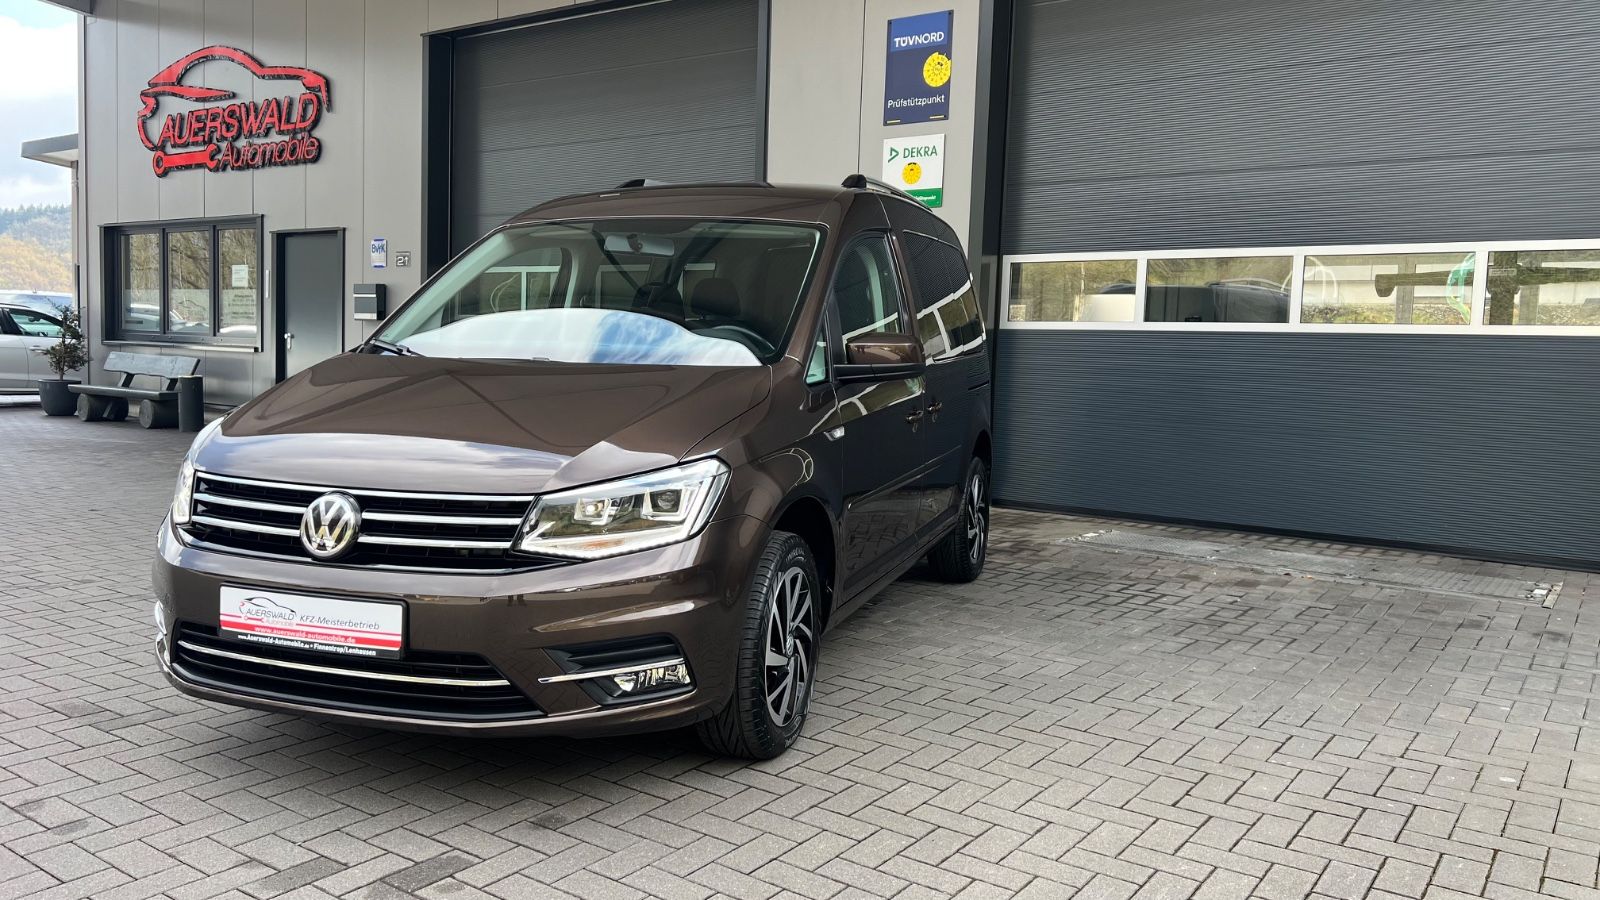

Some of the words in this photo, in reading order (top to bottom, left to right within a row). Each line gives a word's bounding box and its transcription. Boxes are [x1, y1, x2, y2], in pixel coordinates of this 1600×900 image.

[887, 94, 945, 109] Prüfstützpunkt
[156, 91, 320, 148] AUERSWALD
[218, 132, 320, 170] Automobile
[902, 145, 938, 159] DEKRA
[246, 607, 295, 621] AUERSWALD
[299, 614, 380, 630] KFZ-Meisterbetrieb
[254, 627, 356, 644] www.auerswald-automobile.de
